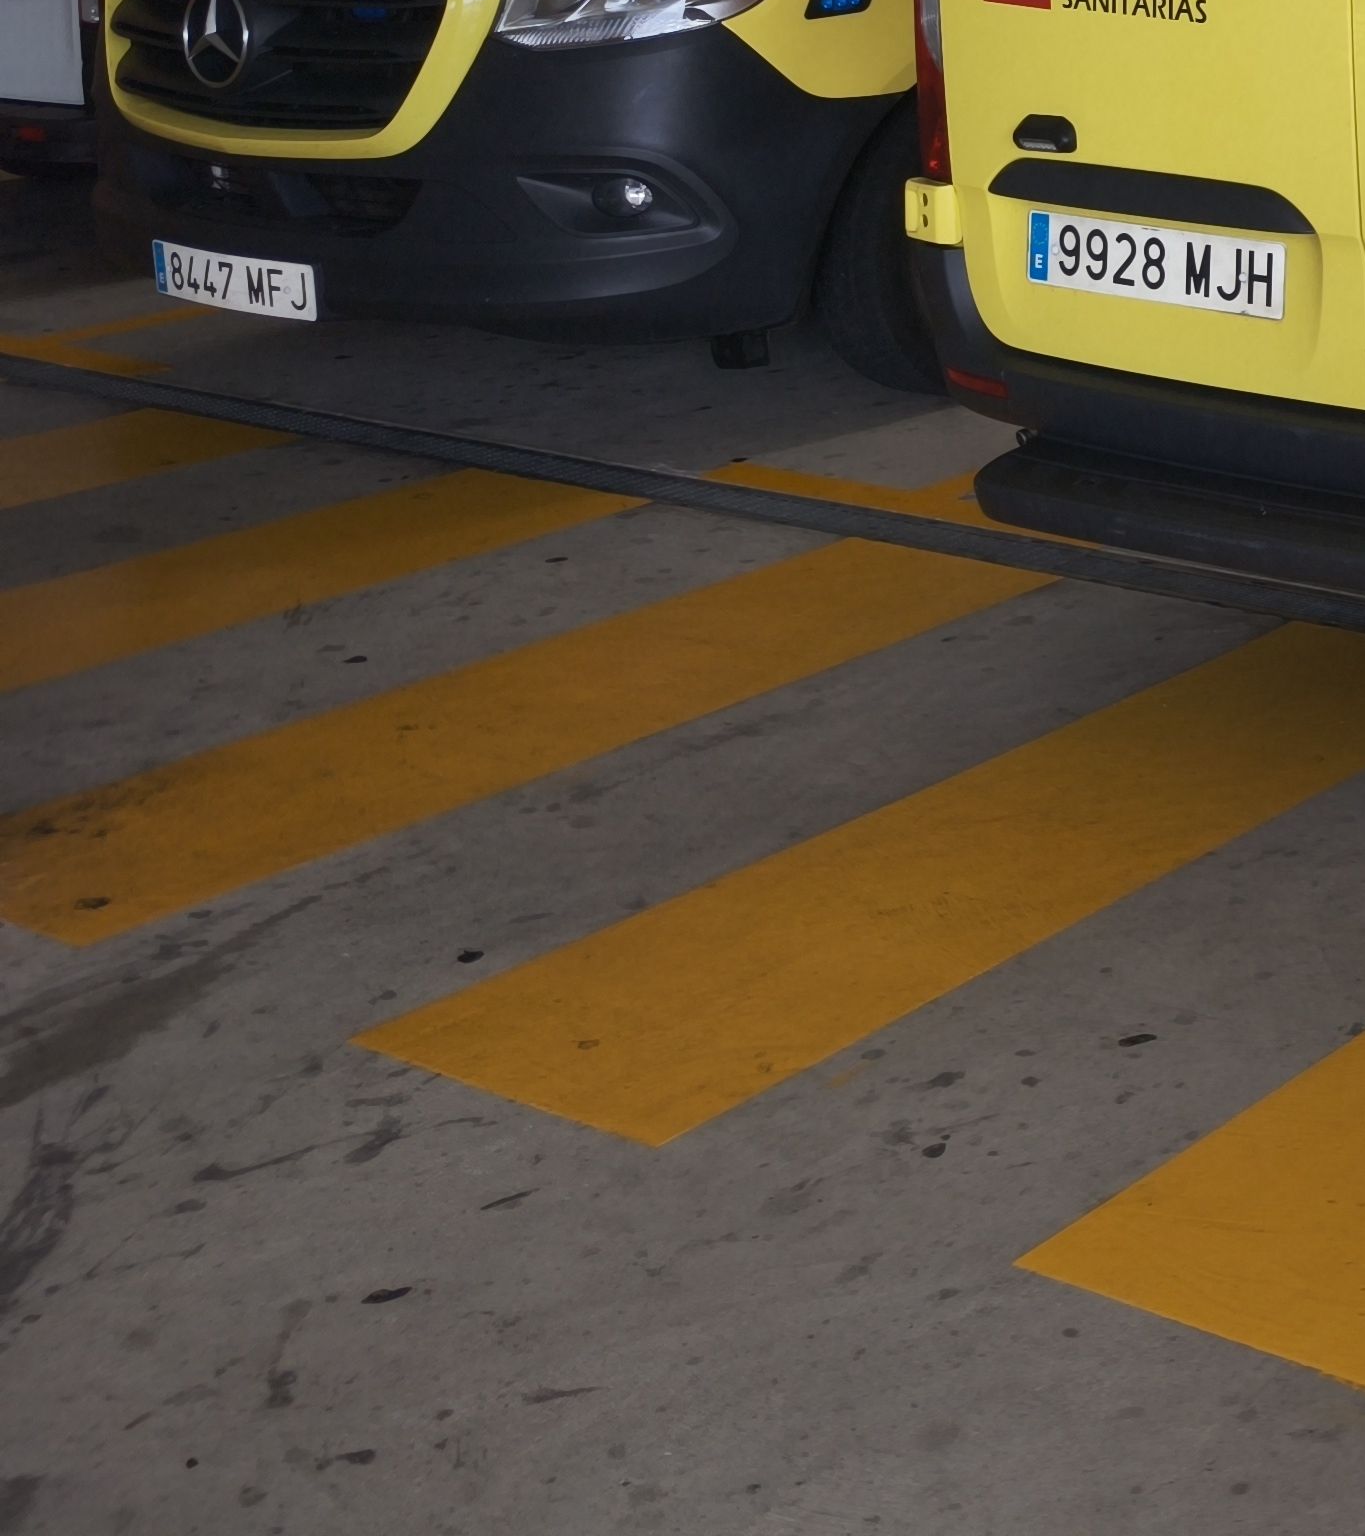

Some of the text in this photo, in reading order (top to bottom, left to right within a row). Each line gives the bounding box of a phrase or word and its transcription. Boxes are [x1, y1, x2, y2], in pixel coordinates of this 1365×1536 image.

[158, 252, 307, 311] E 8447 MFJ
[1034, 224, 1273, 307] E 9928 MJH
